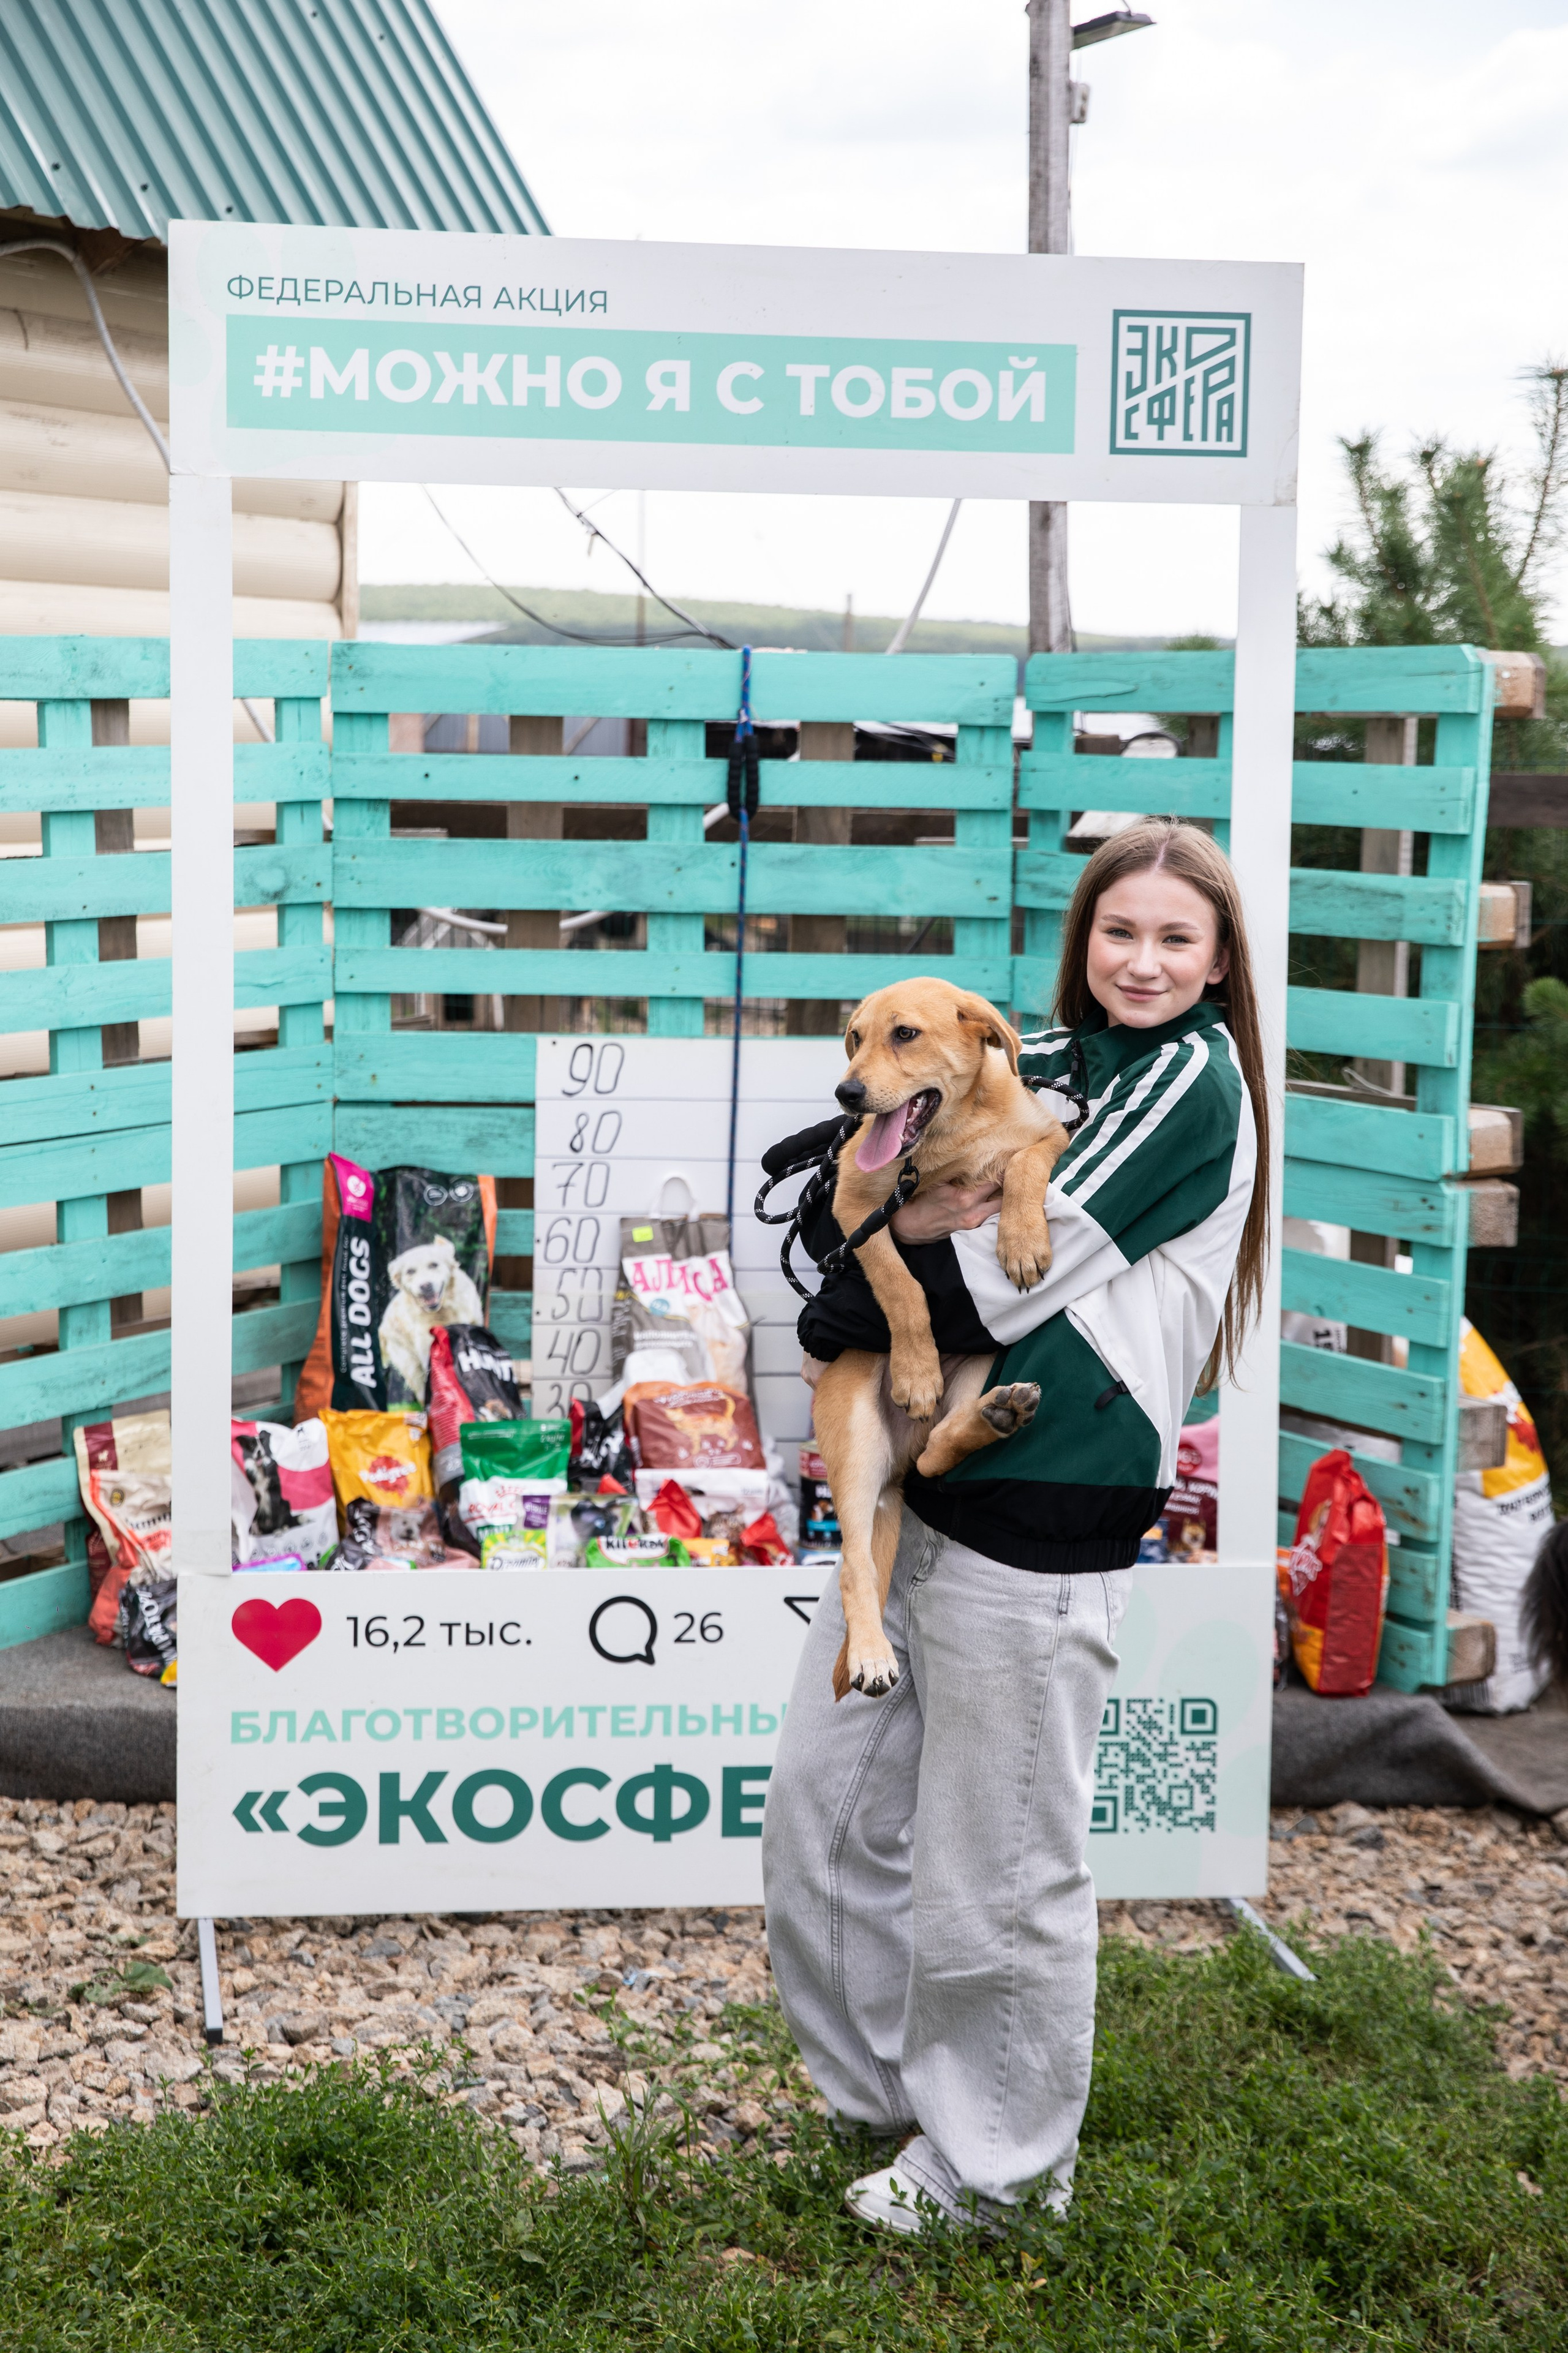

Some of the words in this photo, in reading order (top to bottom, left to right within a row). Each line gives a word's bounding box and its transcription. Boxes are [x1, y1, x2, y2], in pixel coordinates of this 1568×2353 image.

[227, 274, 482, 309] ФЕДЕРАЛЬНАЯ
[492, 286, 608, 317] АКЦИЯ
[253, 344, 622, 410] #МОЖНО
[645, 360, 691, 412] Я
[715, 361, 765, 415] С
[786, 356, 1047, 423] ТОБОЙ
[562, 1042, 625, 1097] 90
[570, 1110, 622, 1154] 80
[552, 1161, 610, 1208] 70
[543, 1216, 600, 1263] 60
[347, 1236, 372, 1327] DOGS
[552, 1267, 603, 1322] 50
[350, 1331, 378, 1388] ALL
[547, 1328, 601, 1376] 40
[359, 1462, 417, 1483] Pedigree
[345, 1614, 426, 1654] 16,2
[440, 1621, 532, 1647] тыс.
[673, 1613, 724, 1644] 26
